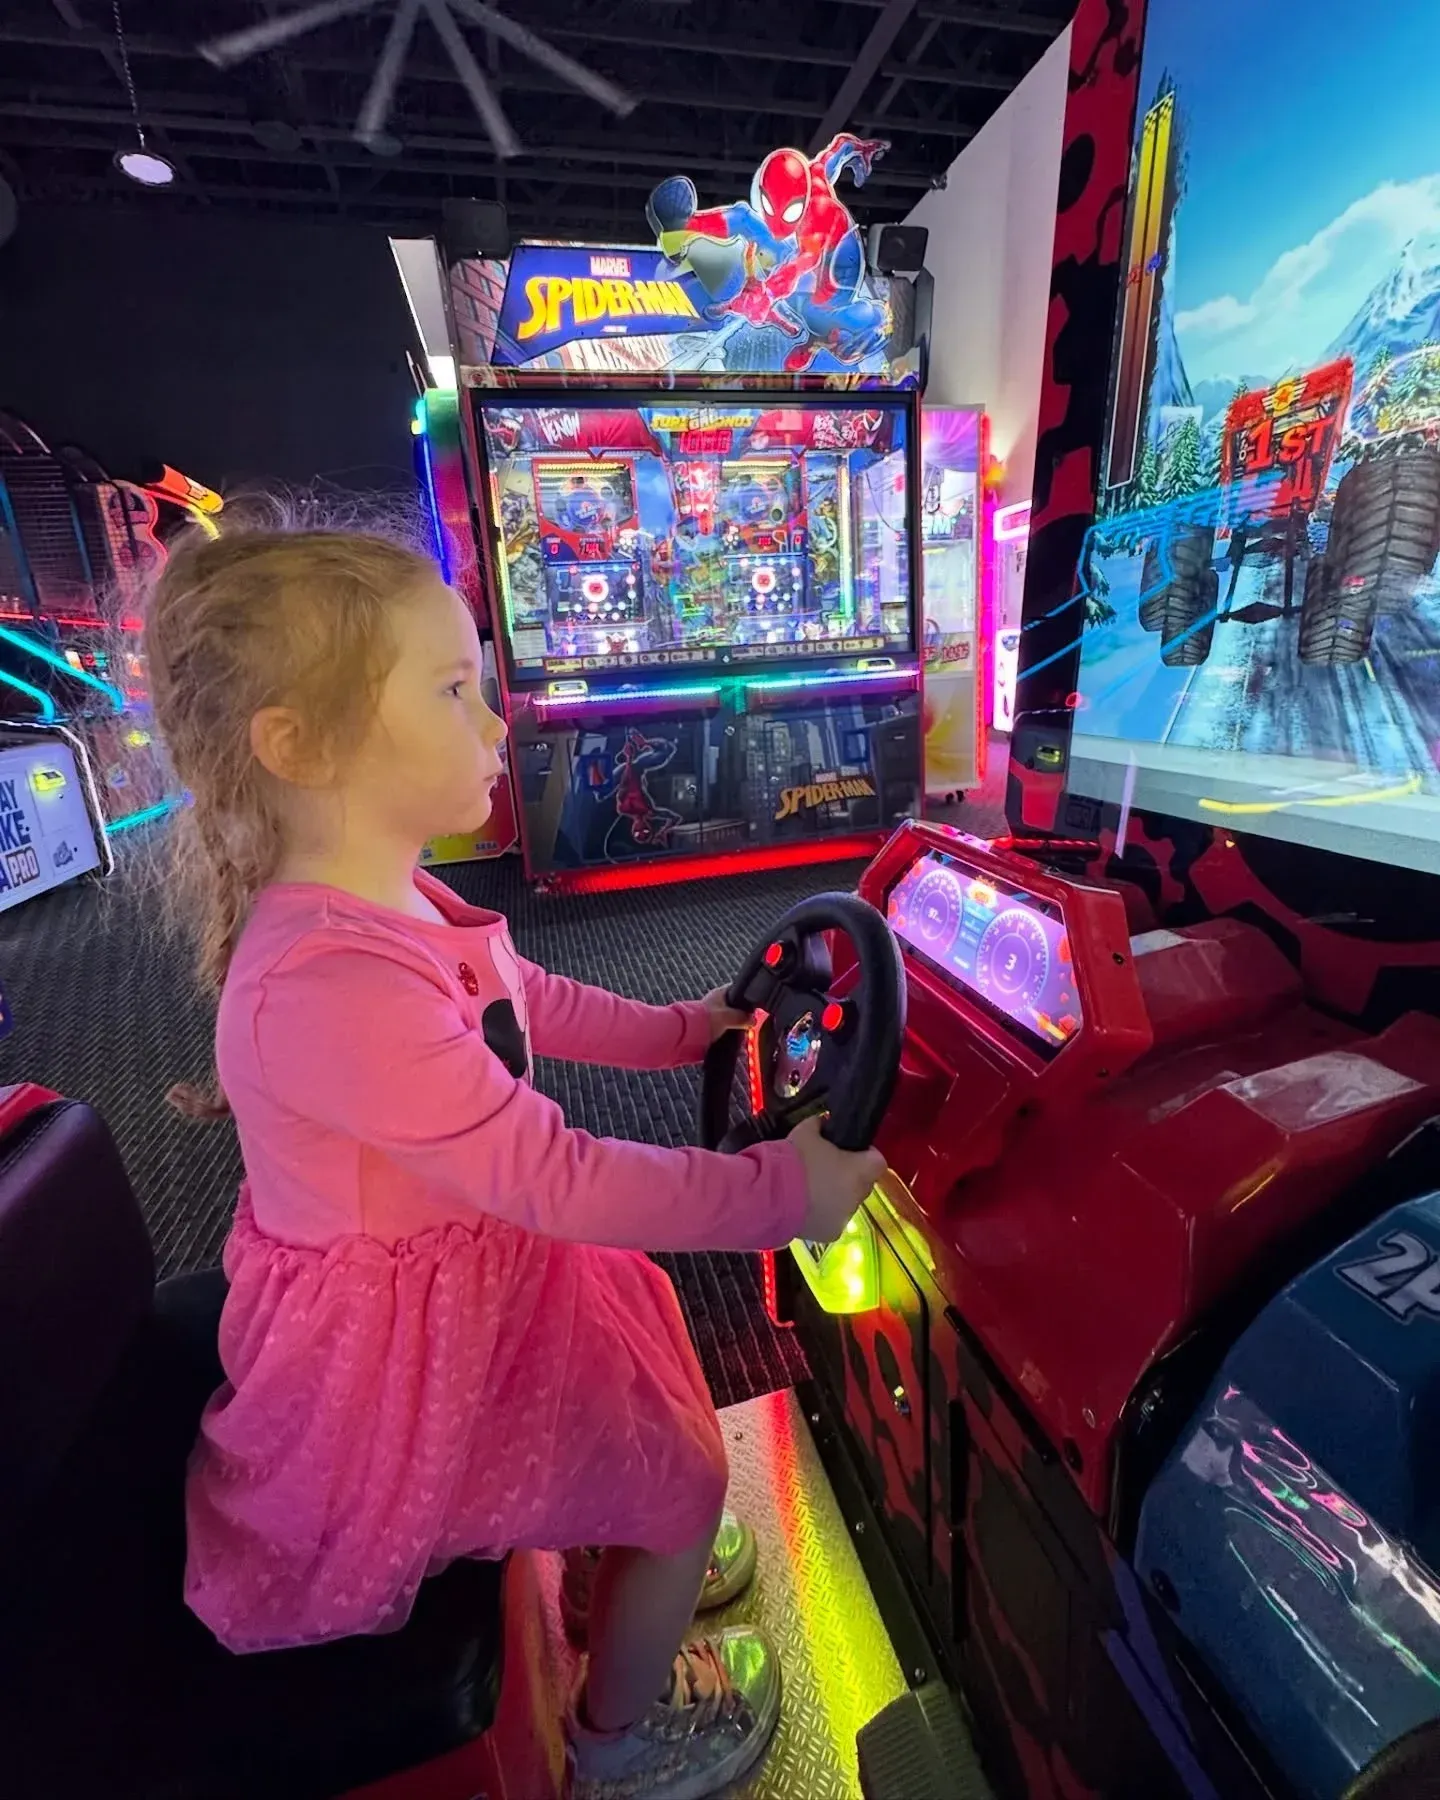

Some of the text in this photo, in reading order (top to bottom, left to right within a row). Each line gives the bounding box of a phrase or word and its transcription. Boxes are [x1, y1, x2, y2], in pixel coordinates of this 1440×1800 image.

[590, 256, 630, 277] MARVEL
[517, 276, 700, 341] SPIDER-MAN
[1246, 415, 1336, 472] 1ST
[774, 779, 876, 820] SPIDER-MAN
[6, 846, 40, 888] PRO
[1005, 953, 1017, 971] 3
